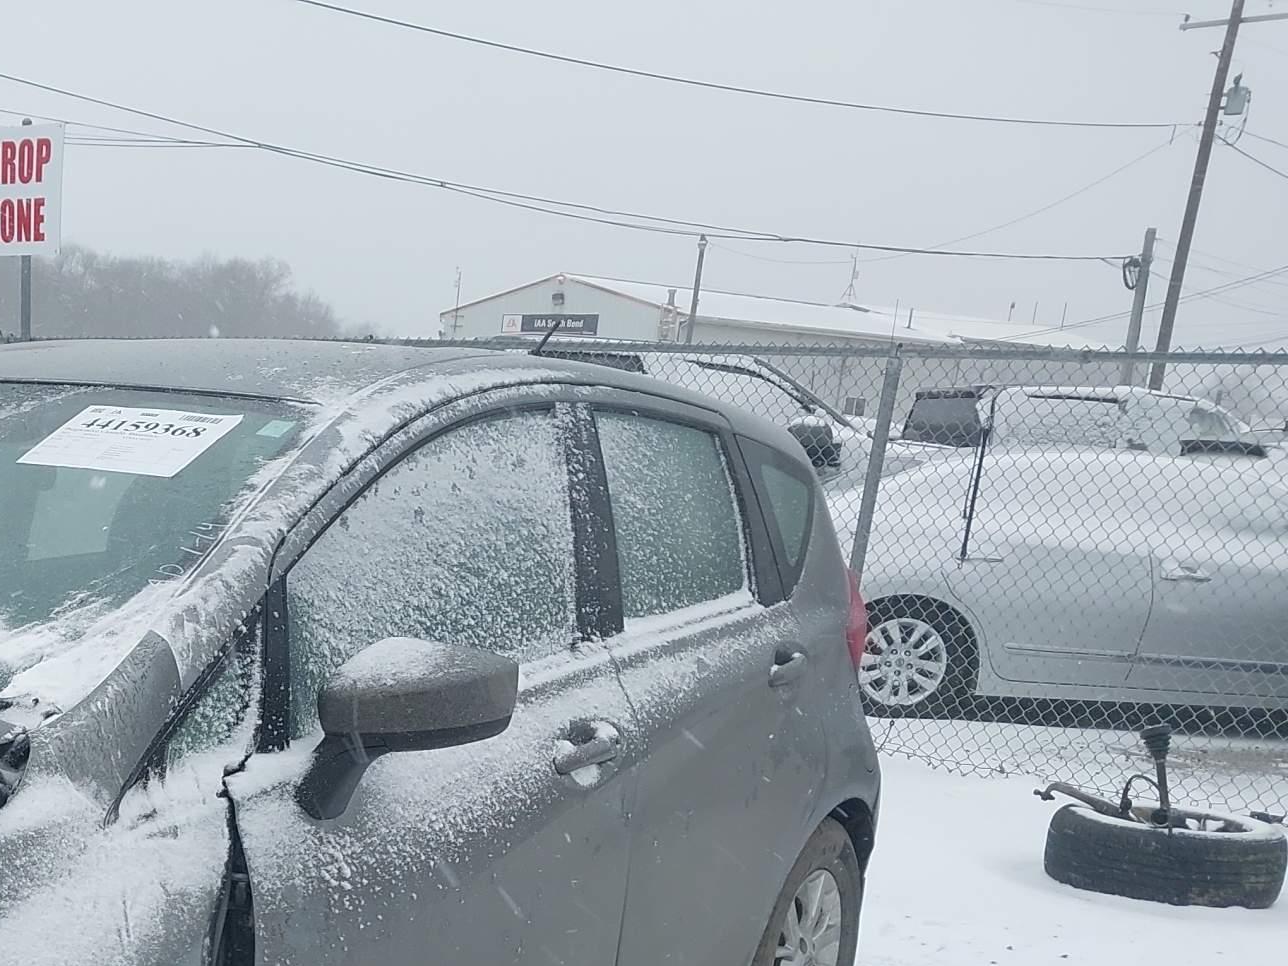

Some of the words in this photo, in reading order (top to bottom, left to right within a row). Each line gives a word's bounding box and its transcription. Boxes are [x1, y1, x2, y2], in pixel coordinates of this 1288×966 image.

[547, 318, 565, 328] Soth
[566, 318, 584, 328] Bend
[81, 417, 208, 438] 44159368
